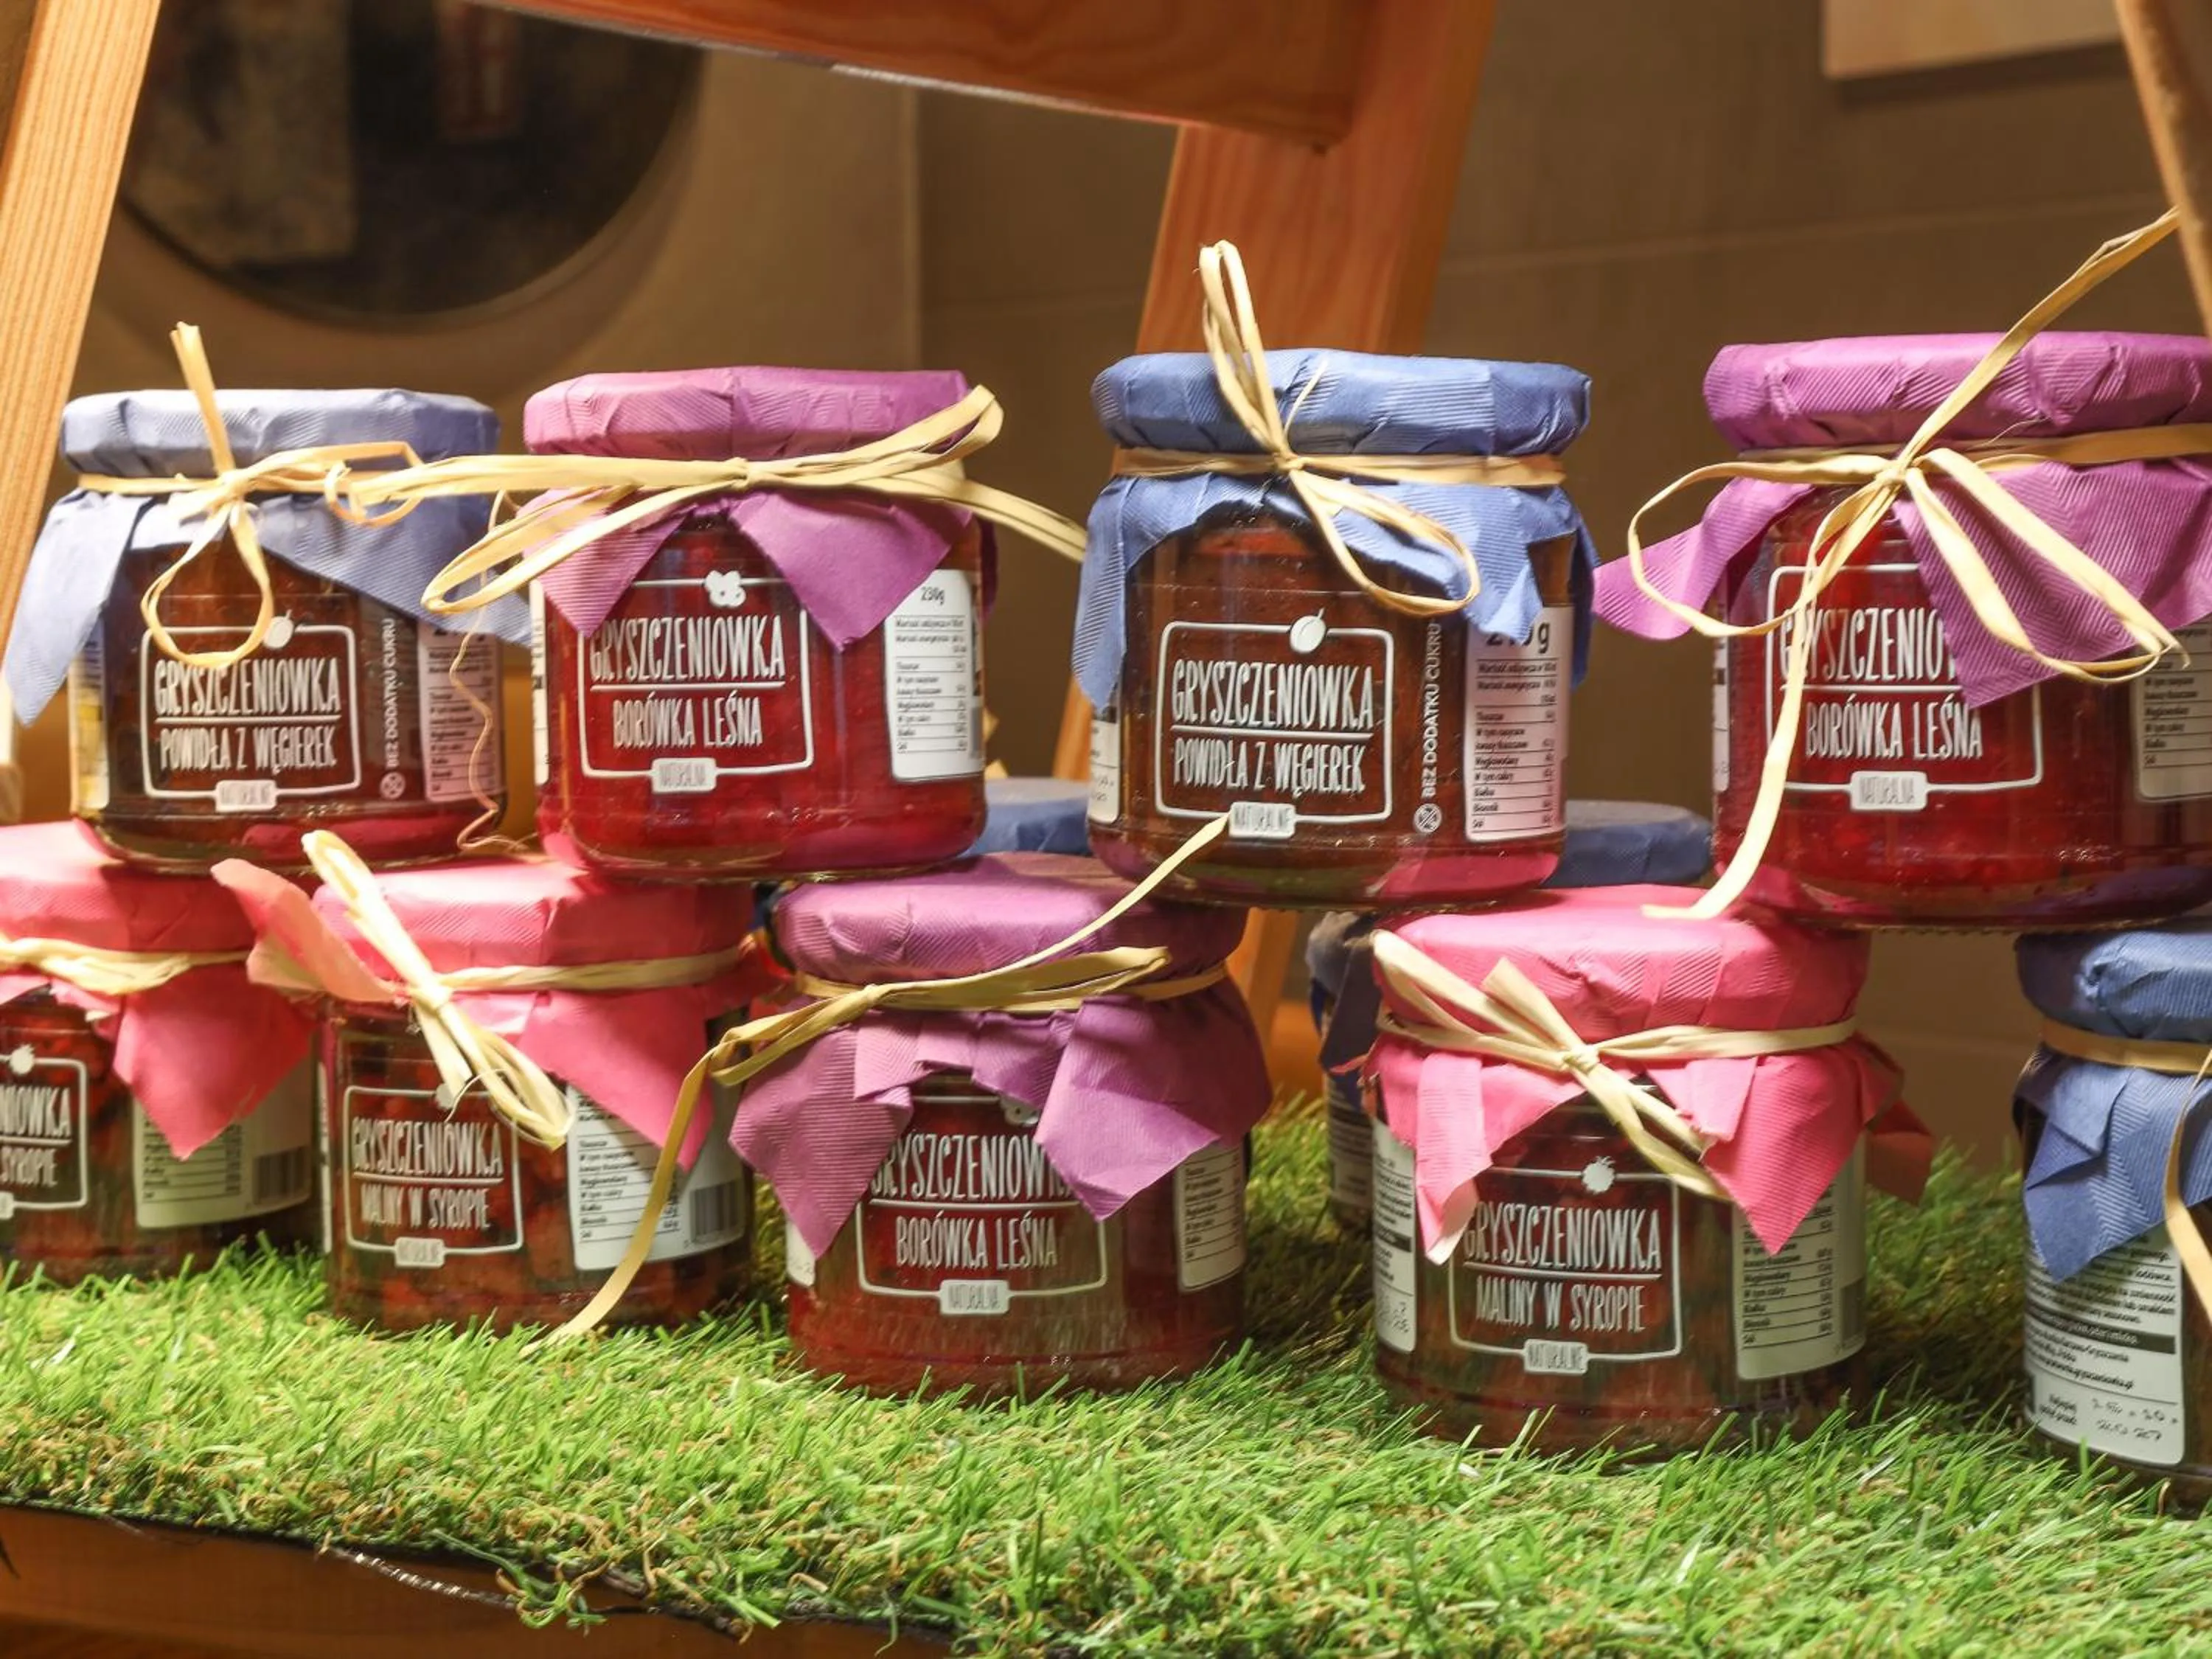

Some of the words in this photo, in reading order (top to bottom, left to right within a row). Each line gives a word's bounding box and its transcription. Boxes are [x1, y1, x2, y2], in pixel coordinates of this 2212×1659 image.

[381, 618, 397, 667] CUKRU
[589, 615, 786, 681] GRYSZCZENIOWKA
[1425, 623, 1441, 681] CUKRU
[1779, 607, 1956, 681] GYSZCZENIO
[153, 658, 341, 716] GRYSZCZENIOWKA
[383, 669, 399, 740] DODATKU
[1172, 658, 1374, 730] GRYSZCZENIOWKA
[613, 691, 695, 748] BORÓWKA
[703, 690, 763, 748] LEŚNA
[1422, 683, 1440, 765] DODATKU
[1806, 693, 1904, 759] BORÓWKA
[1913, 693, 1983, 759] LEŚNA
[160, 727, 232, 771] POWIDŁA
[234, 727, 248, 771] Z
[252, 726, 338, 775] WĘGIEREK
[385, 741, 400, 769] BEZ
[1174, 737, 1248, 790] POWIDŁA
[1254, 740, 1267, 790] Z
[1273, 742, 1366, 799] WĘGIEREK
[1421, 766, 1437, 799] BEZ
[352, 1116, 504, 1178] GRYSZCZENIOWKA
[870, 1130, 1074, 1200] RYSZCZENIOW
[361, 1183, 405, 1227] MALINY
[408, 1186, 425, 1228] W
[428, 1186, 490, 1231] SYROPIE
[896, 1210, 989, 1270] BORÓWKA
[996, 1210, 1058, 1270] LEŚNA
[1475, 1274, 1538, 1327] MALINY
[1543, 1281, 1564, 1330] W
[1569, 1283, 1646, 1332] SYROPIE
